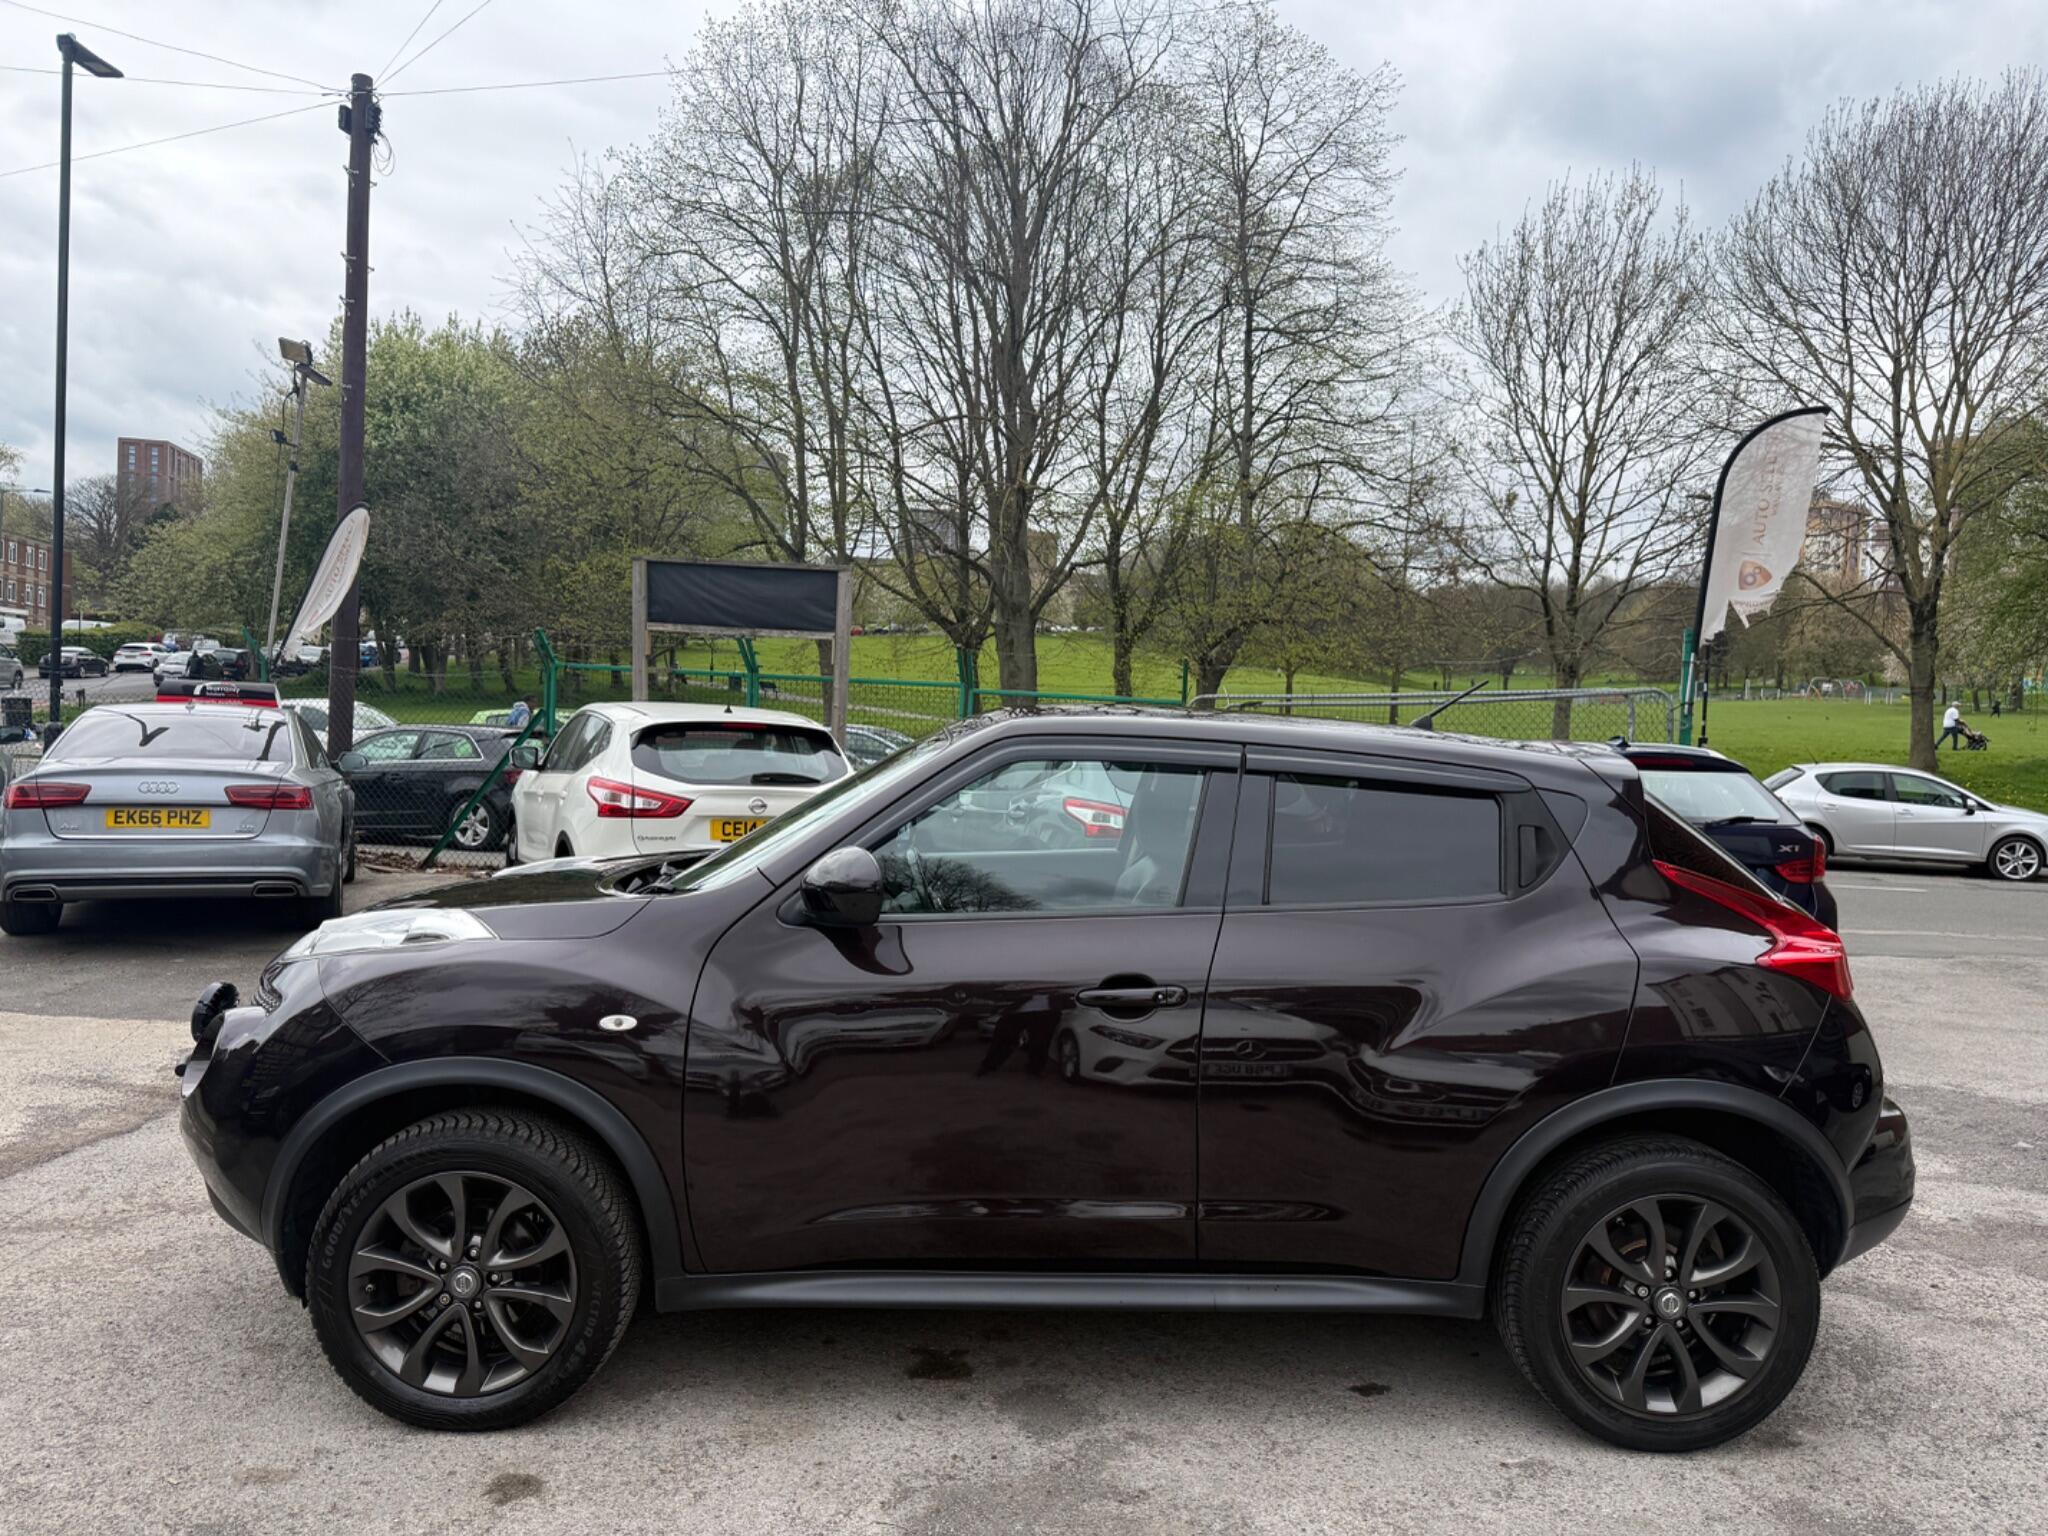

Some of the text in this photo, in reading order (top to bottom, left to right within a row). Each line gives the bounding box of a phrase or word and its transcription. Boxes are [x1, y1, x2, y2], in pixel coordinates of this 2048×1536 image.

[113, 809, 202, 825] EK66 PHZ
[1777, 844, 1800, 853] X1
